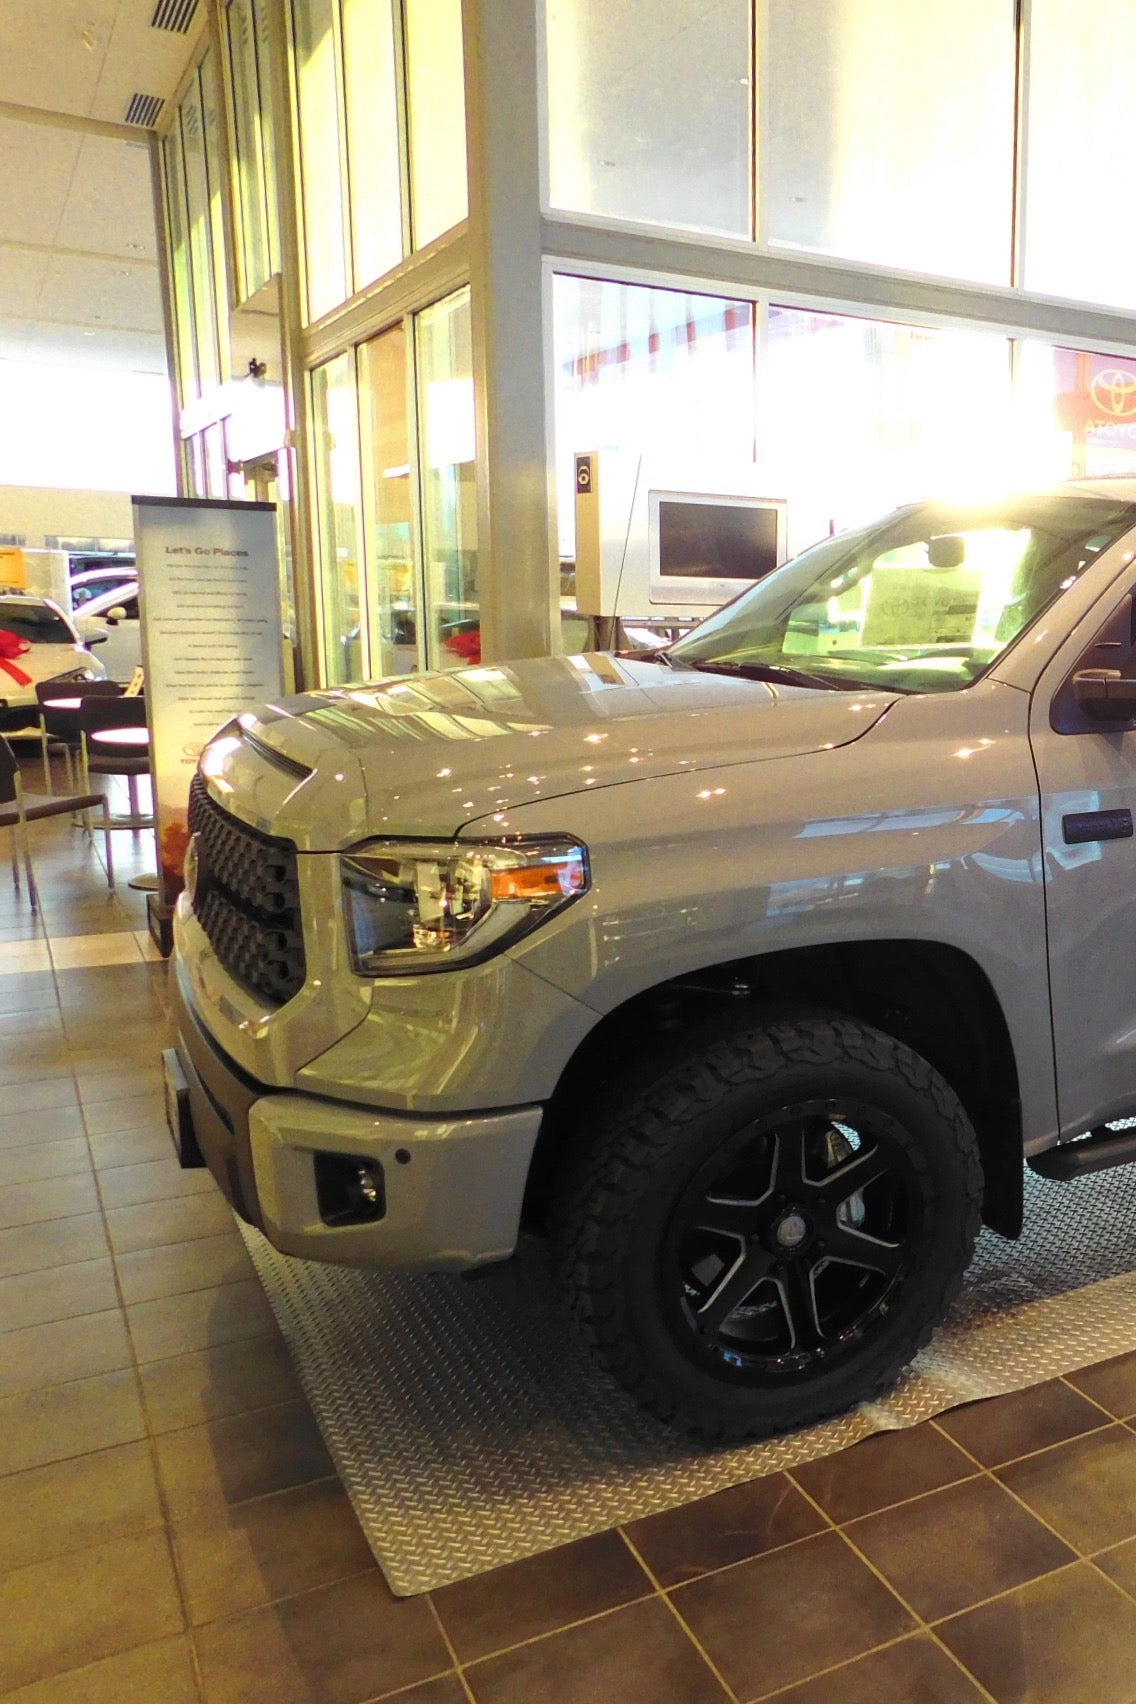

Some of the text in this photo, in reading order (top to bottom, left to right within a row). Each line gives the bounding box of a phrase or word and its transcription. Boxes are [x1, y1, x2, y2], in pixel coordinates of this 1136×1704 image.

[165, 546, 249, 558] Let's Go Places
